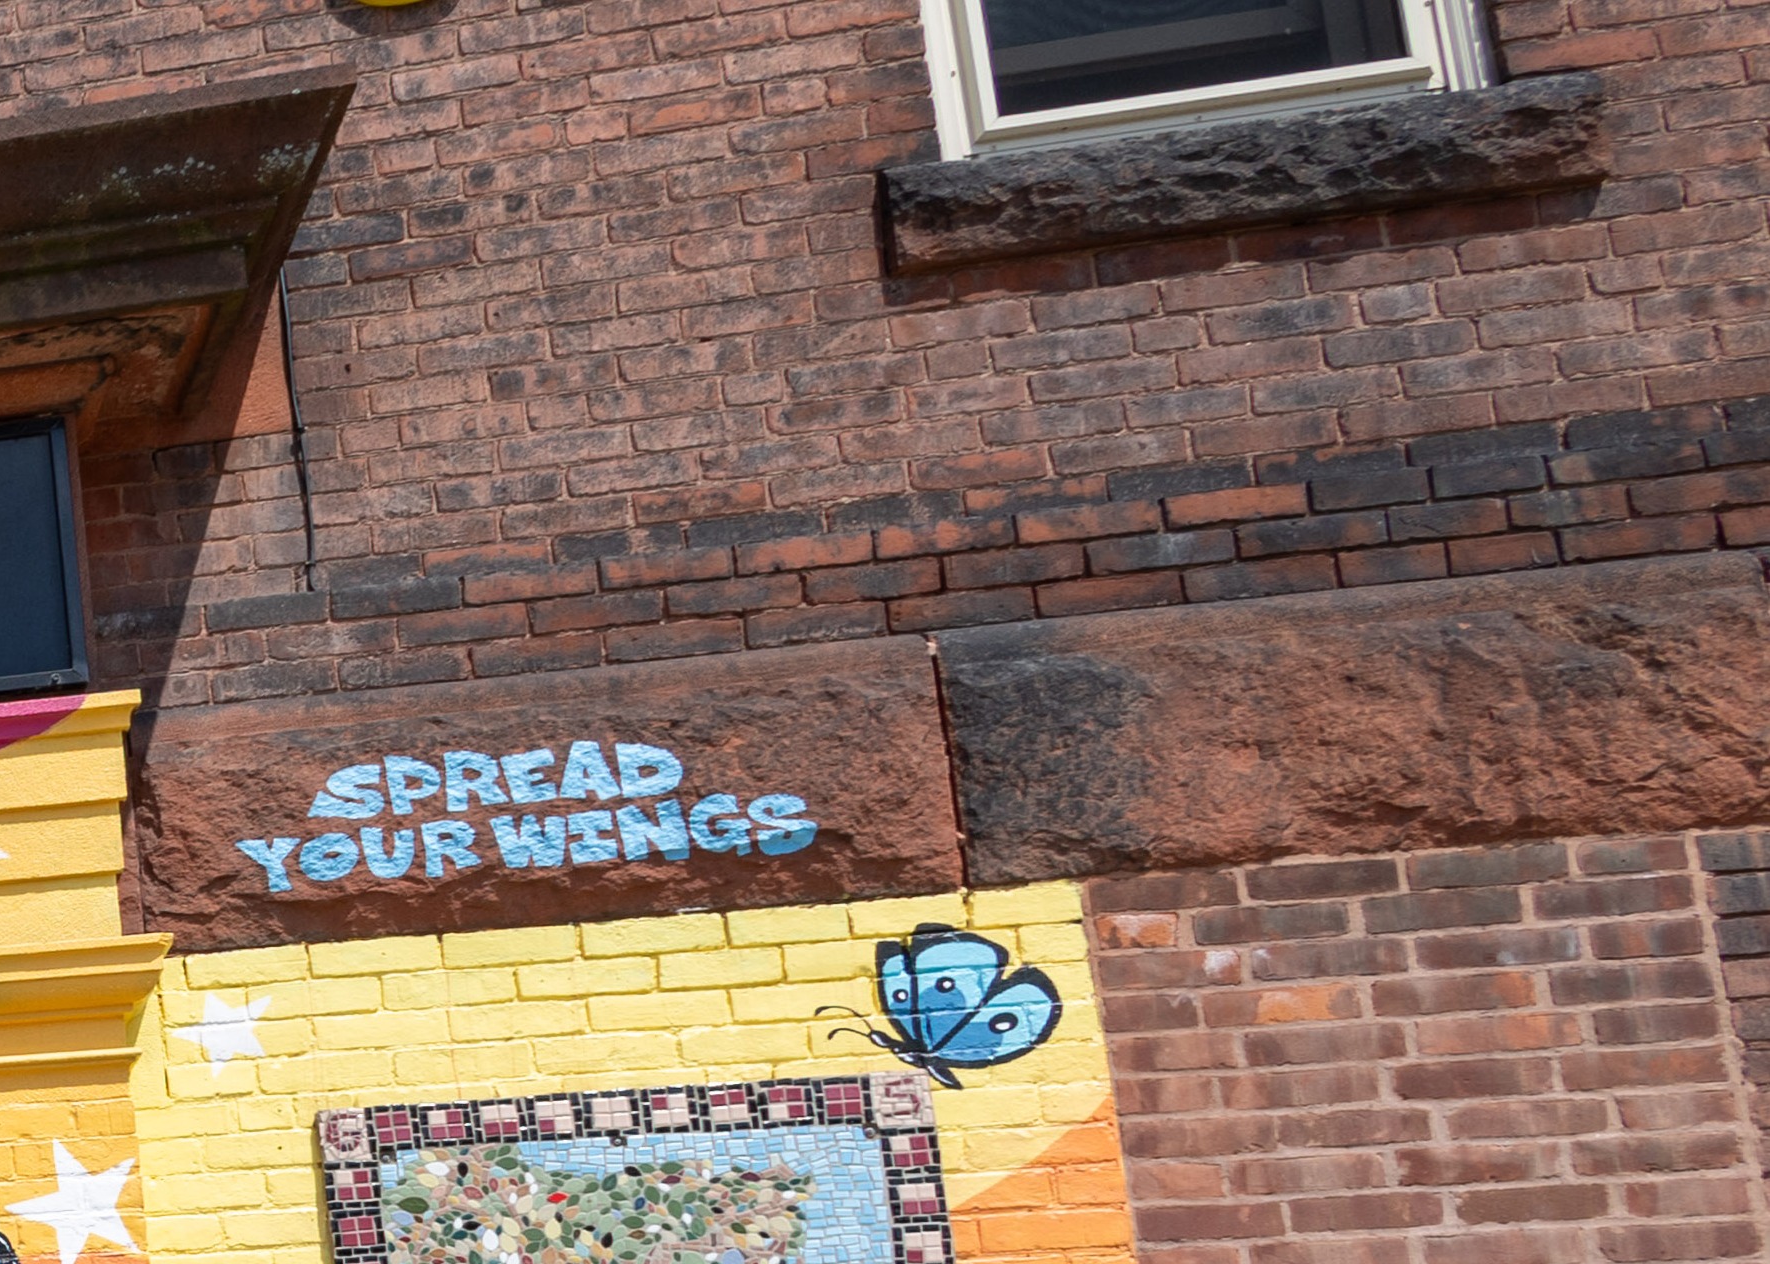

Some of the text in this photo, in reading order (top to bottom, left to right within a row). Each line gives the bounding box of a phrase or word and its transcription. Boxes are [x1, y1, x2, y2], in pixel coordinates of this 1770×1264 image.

[307, 740, 684, 819] SPREAD
[235, 793, 819, 893] YOUR WINGS
